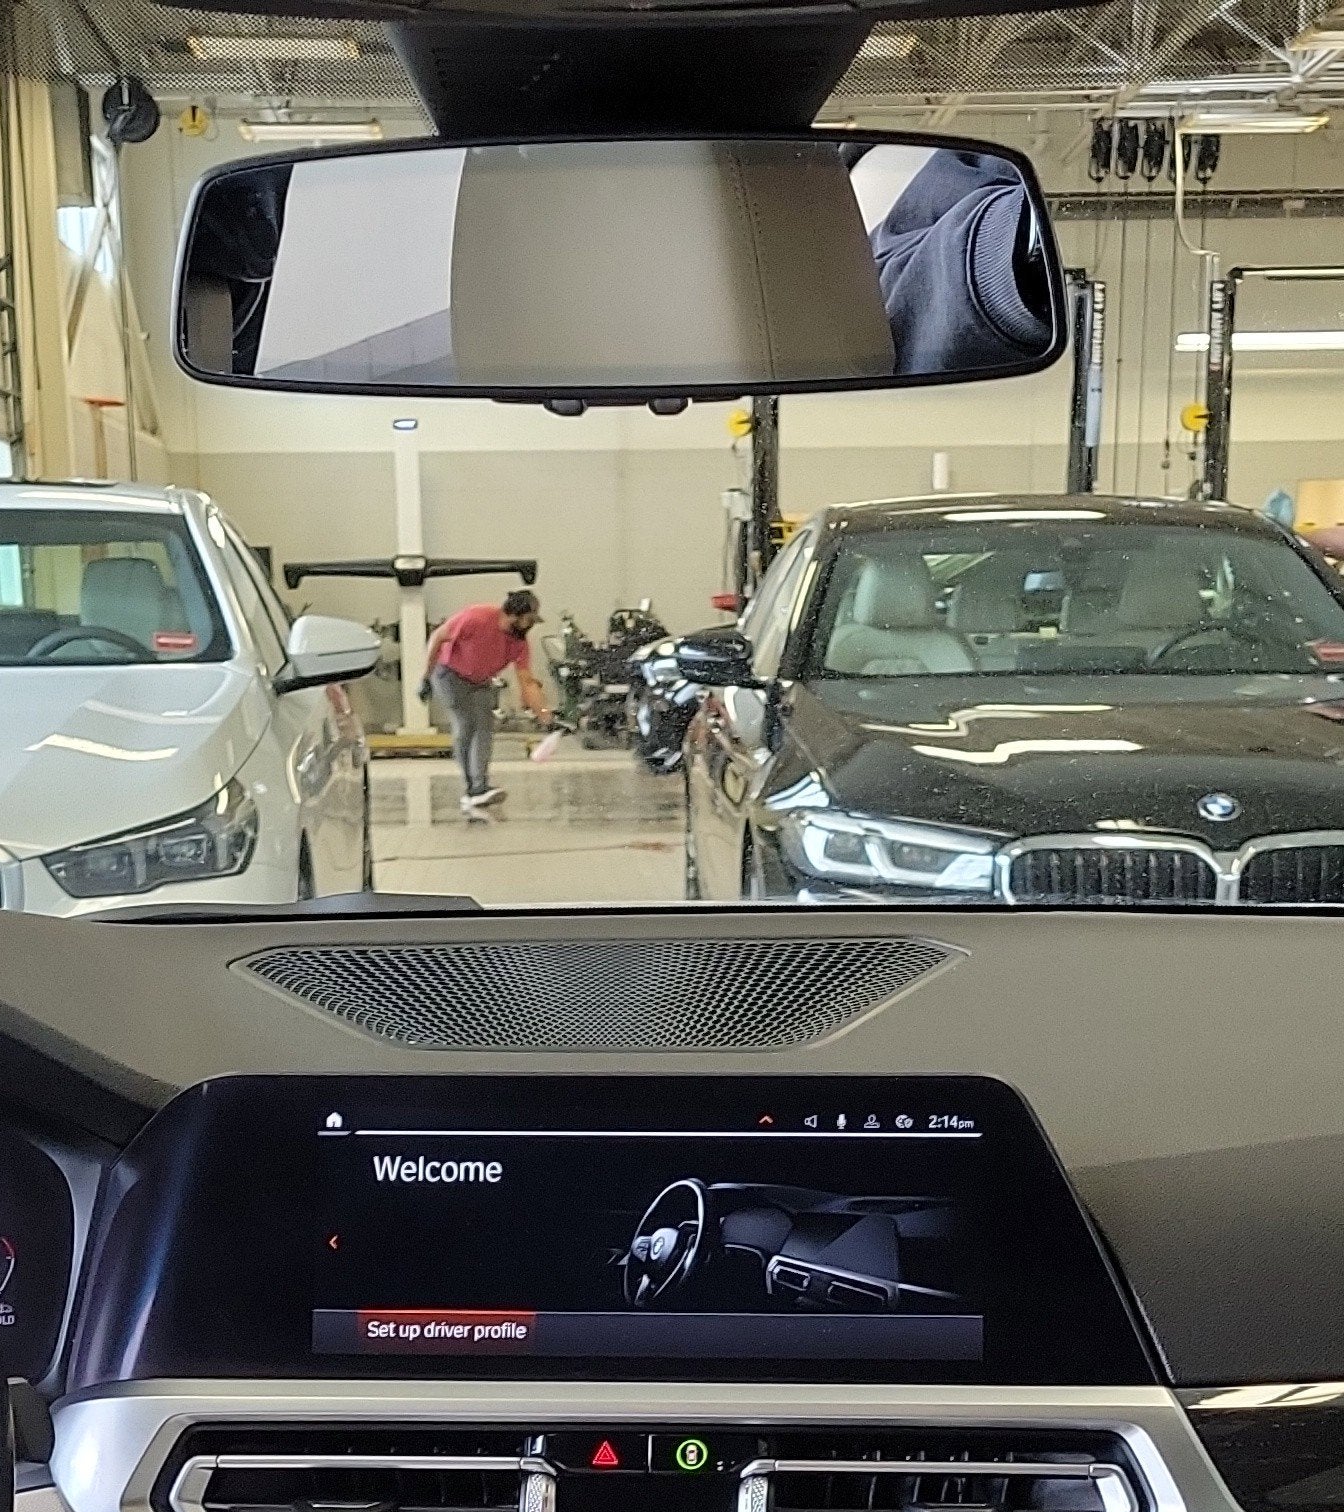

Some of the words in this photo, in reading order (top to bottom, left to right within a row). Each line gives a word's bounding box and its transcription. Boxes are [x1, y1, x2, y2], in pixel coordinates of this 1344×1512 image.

[372, 1154, 503, 1184] Welcome
[367, 1321, 397, 1338] Set
[399, 1325, 421, 1341] up
[424, 1321, 472, 1339] driver
[474, 1322, 528, 1342] profile
